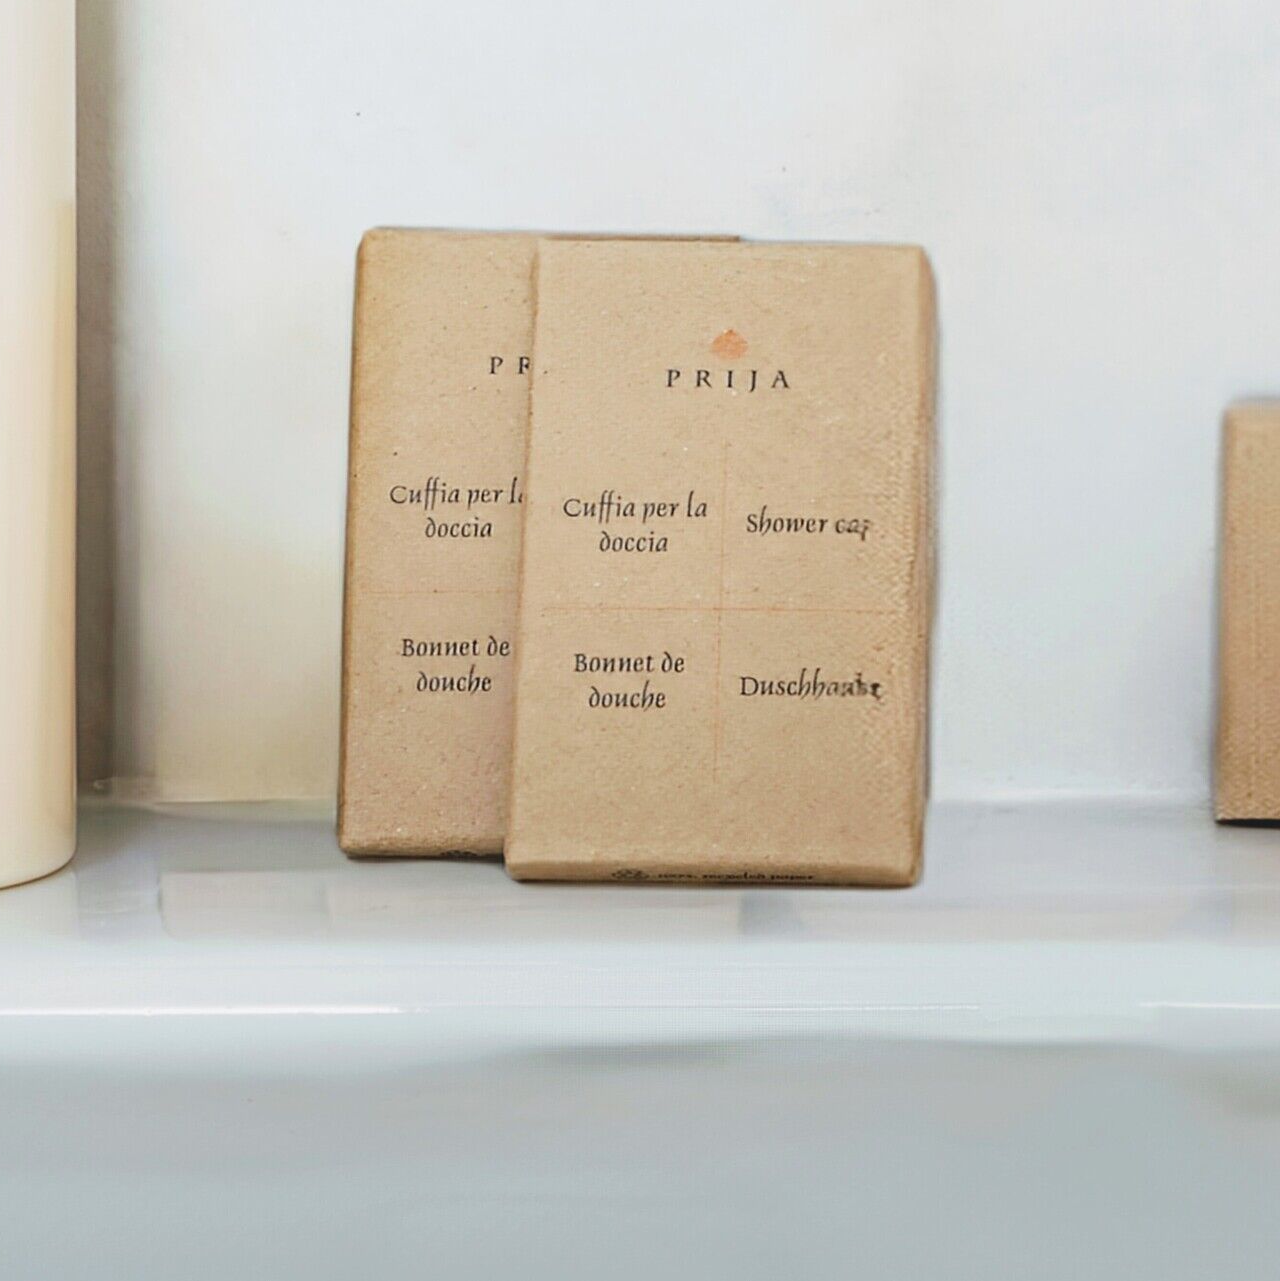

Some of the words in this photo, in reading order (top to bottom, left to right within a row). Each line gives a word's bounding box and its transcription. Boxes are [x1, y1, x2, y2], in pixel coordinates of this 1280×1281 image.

[665, 367, 792, 394] PRIJA
[388, 475, 462, 512] Cuffia
[466, 486, 505, 512] per
[561, 489, 638, 526] Cuffia
[641, 498, 681, 525] per
[685, 490, 710, 519] la
[423, 517, 494, 540] doccia
[745, 504, 829, 537] Shower
[598, 531, 669, 555] doccia
[400, 637, 482, 661] Bonnet
[486, 635, 511, 660] de
[573, 653, 655, 677] Bonnet
[659, 650, 687, 676] de
[415, 664, 494, 696] douche
[587, 679, 668, 712] douche
